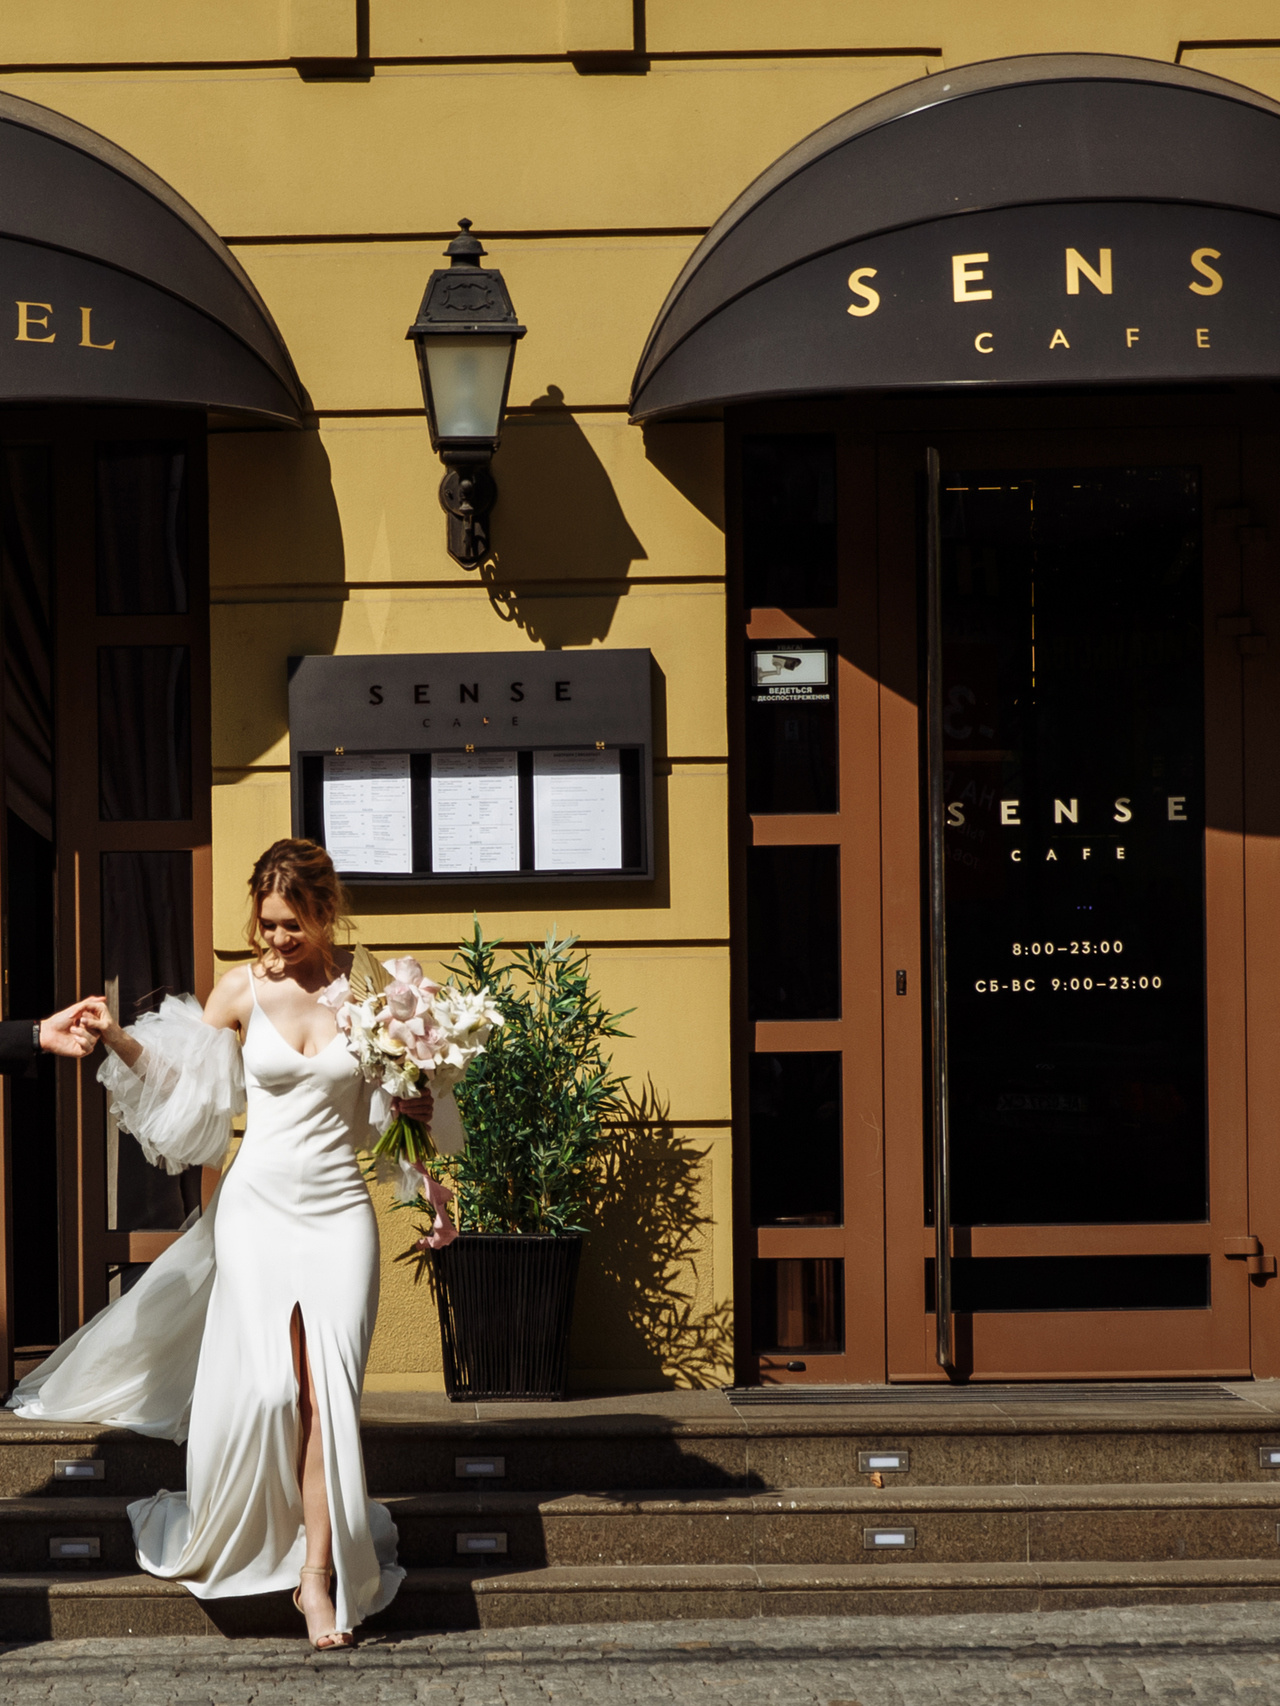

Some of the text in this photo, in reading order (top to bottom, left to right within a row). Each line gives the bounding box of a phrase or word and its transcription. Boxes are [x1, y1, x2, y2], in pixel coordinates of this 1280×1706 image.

[847, 247, 1223, 317] SENS
[974, 328, 1211, 354] CAFE
[368, 681, 572, 706] SENSE
[752, 694, 830, 702] ДЕОСПОСТЕРЕЖЕННЯ
[769, 687, 812, 695] ВЕДЕТЬСЯ
[422, 716, 519, 728] CAFE
[947, 796, 1187, 827] SENSE
[1011, 847, 1125, 862] CAFE
[975, 978, 1036, 993] СБ-ВС
